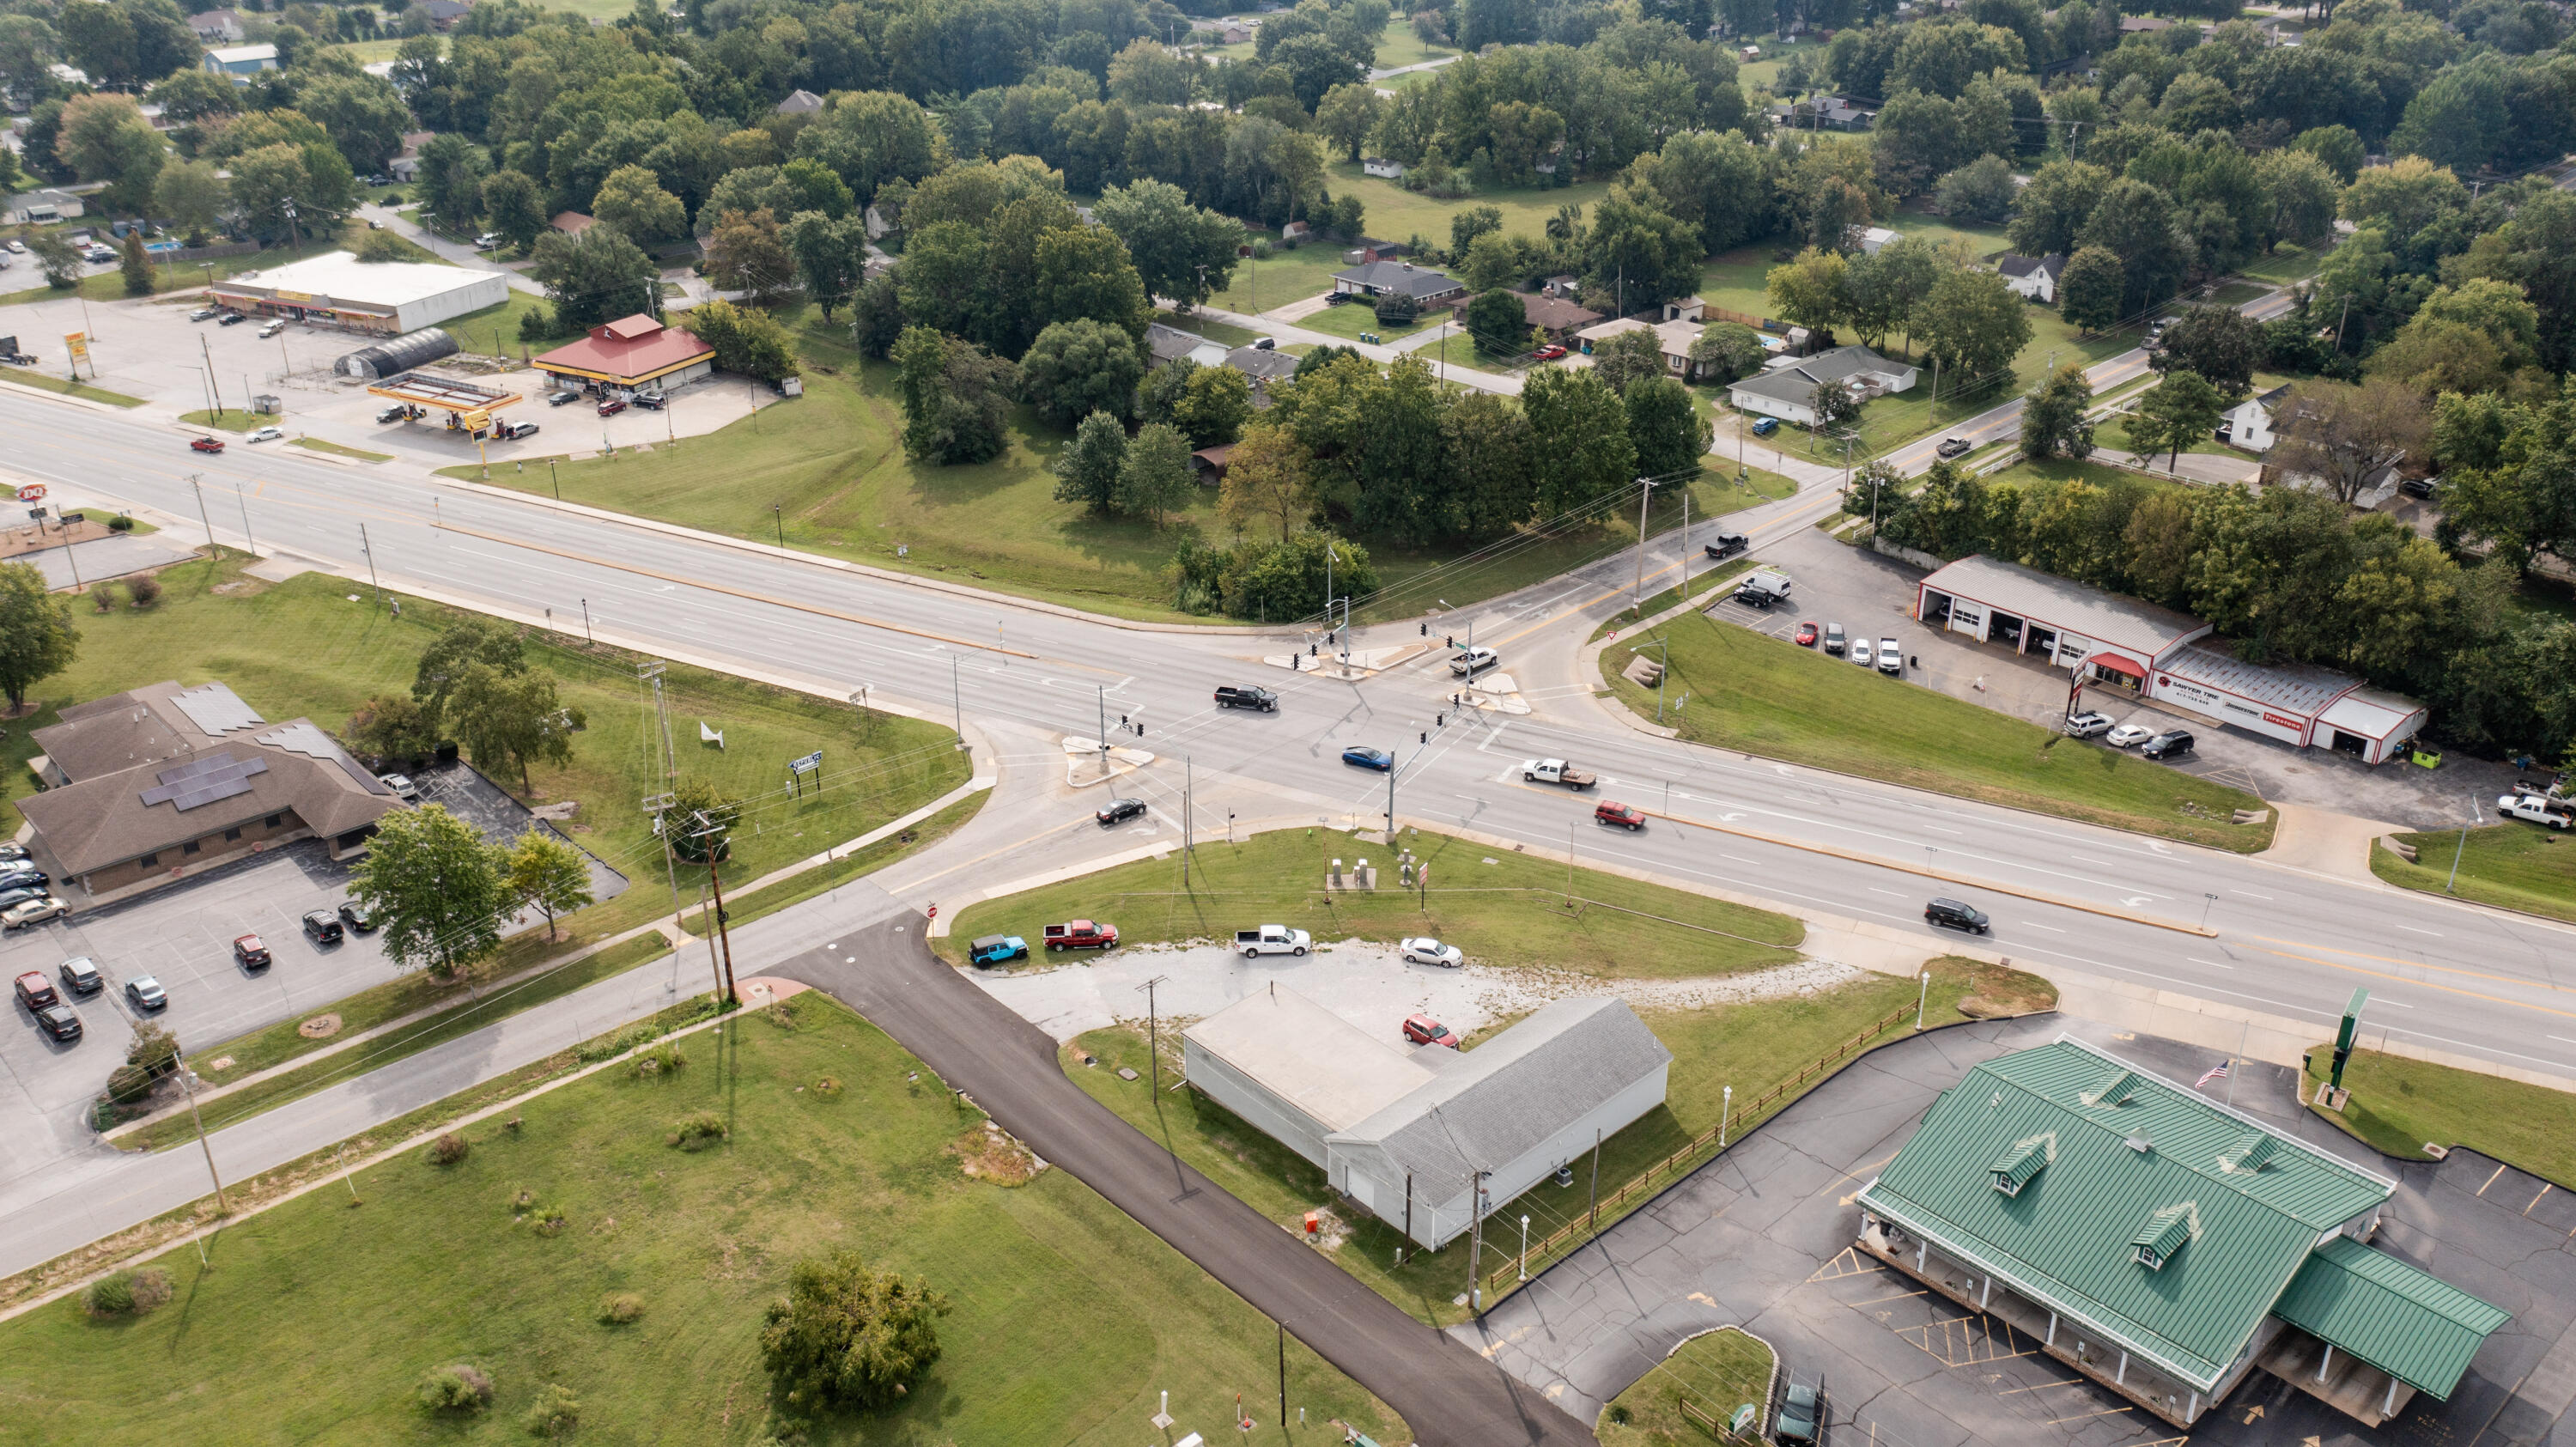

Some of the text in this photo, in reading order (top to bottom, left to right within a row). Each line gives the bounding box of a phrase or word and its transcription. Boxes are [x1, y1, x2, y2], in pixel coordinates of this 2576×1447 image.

[24, 487, 43, 498] DQ
[2172, 681, 2202, 695] SAWYER
[2203, 691, 2220, 701] TIRE
[2264, 714, 2300, 729] Firestone
